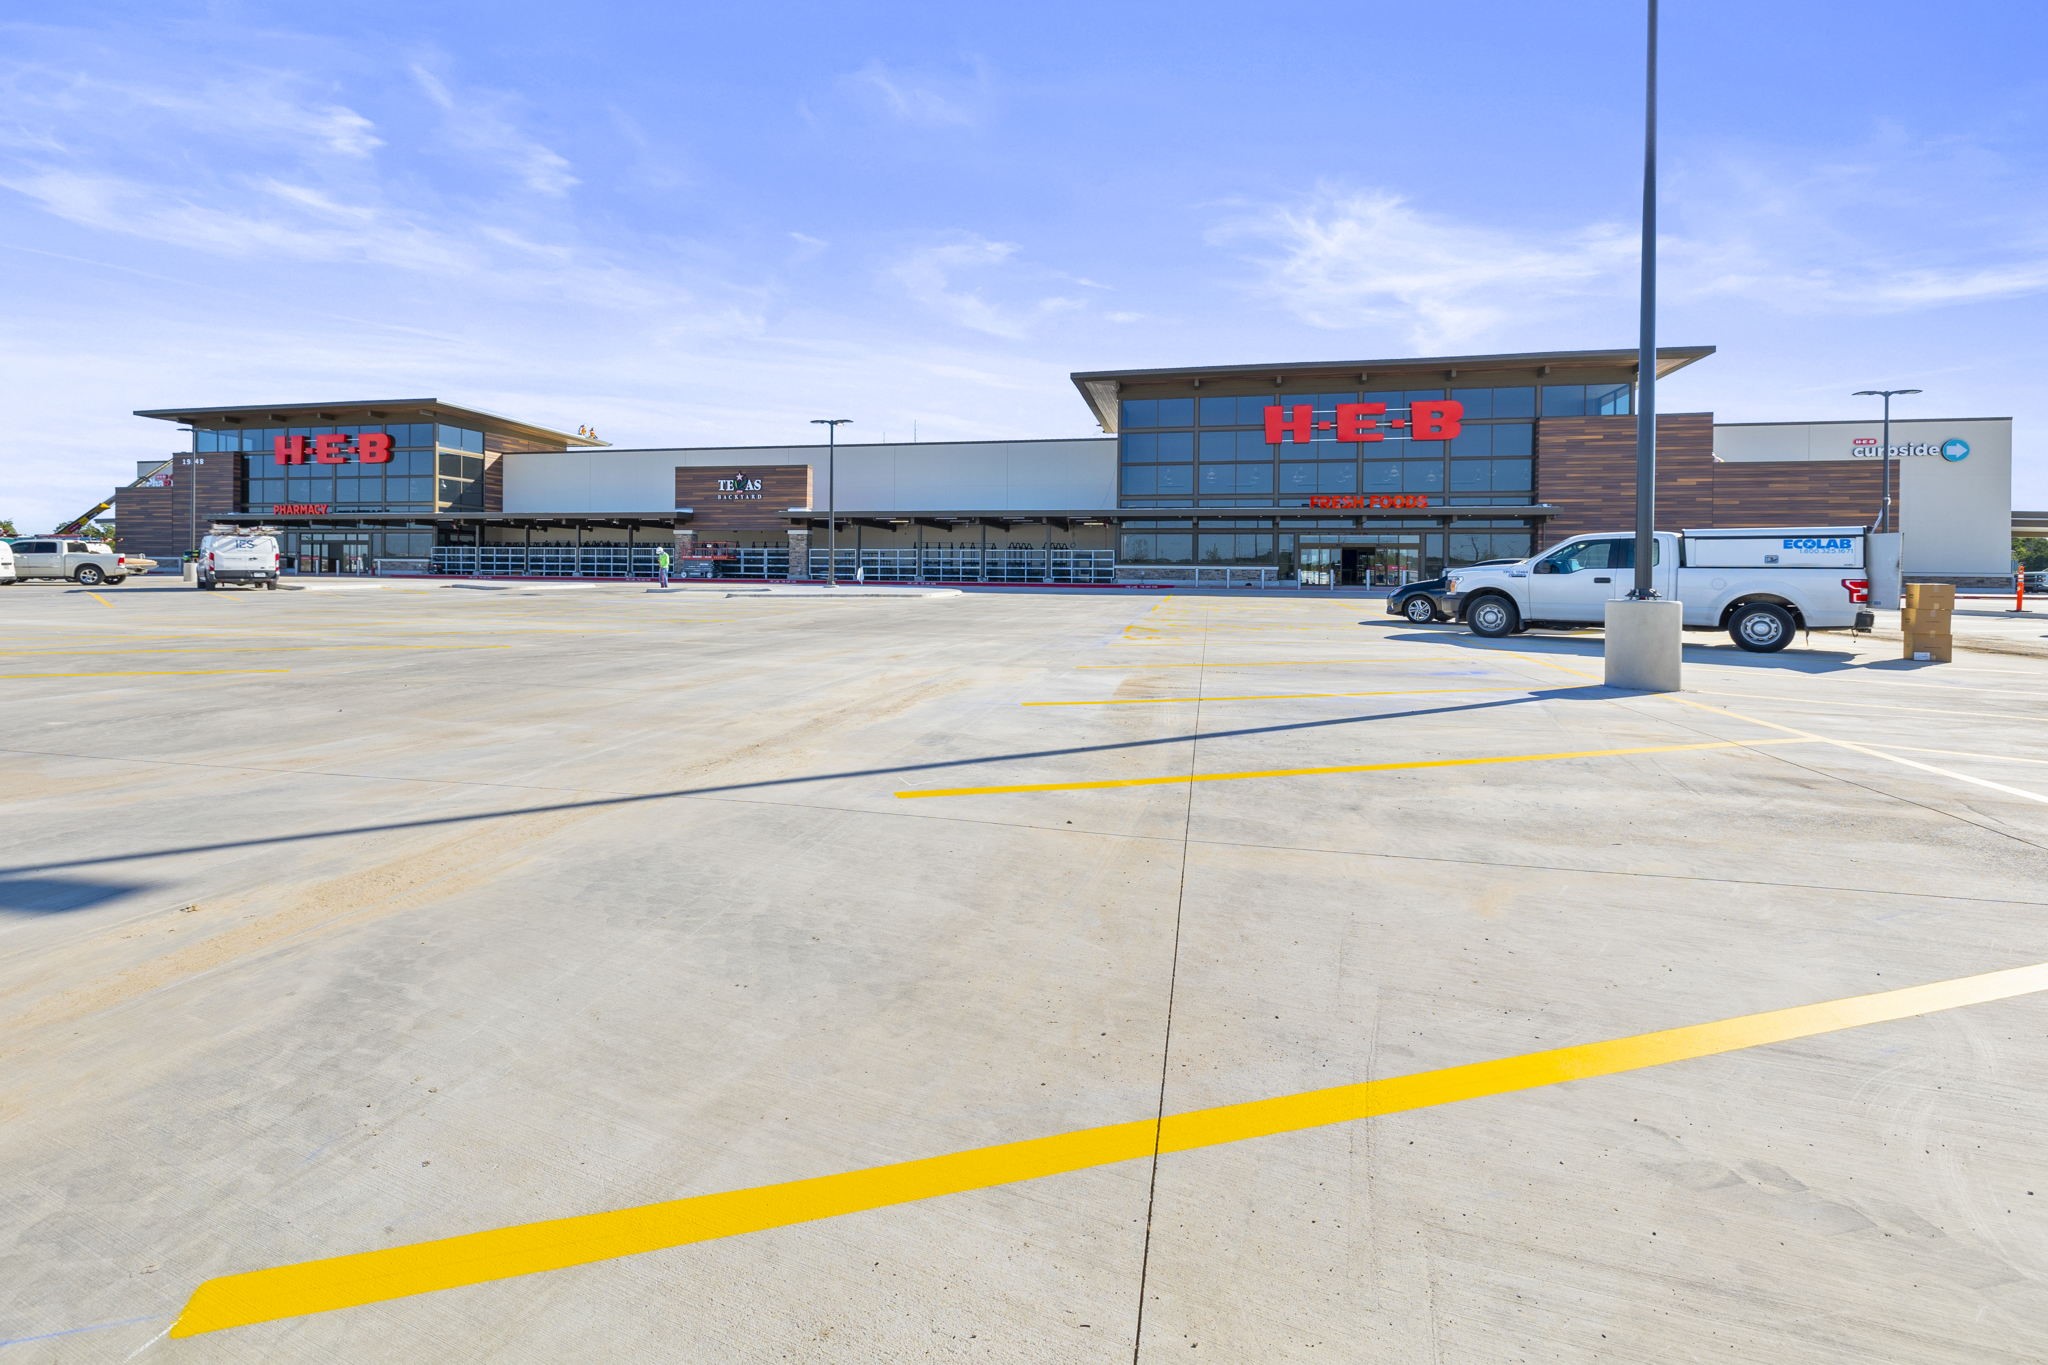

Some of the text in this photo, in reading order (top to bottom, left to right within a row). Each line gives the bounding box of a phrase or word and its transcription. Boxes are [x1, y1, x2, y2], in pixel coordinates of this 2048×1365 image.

[1264, 400, 1464, 444] H-E-B
[274, 432, 393, 465] H-E-B
[1853, 443, 1940, 457] curbside
[1310, 495, 1428, 509] FRESH FOODS
[273, 504, 329, 515] PHARMACY
[1783, 538, 1852, 549] ECOLAB
